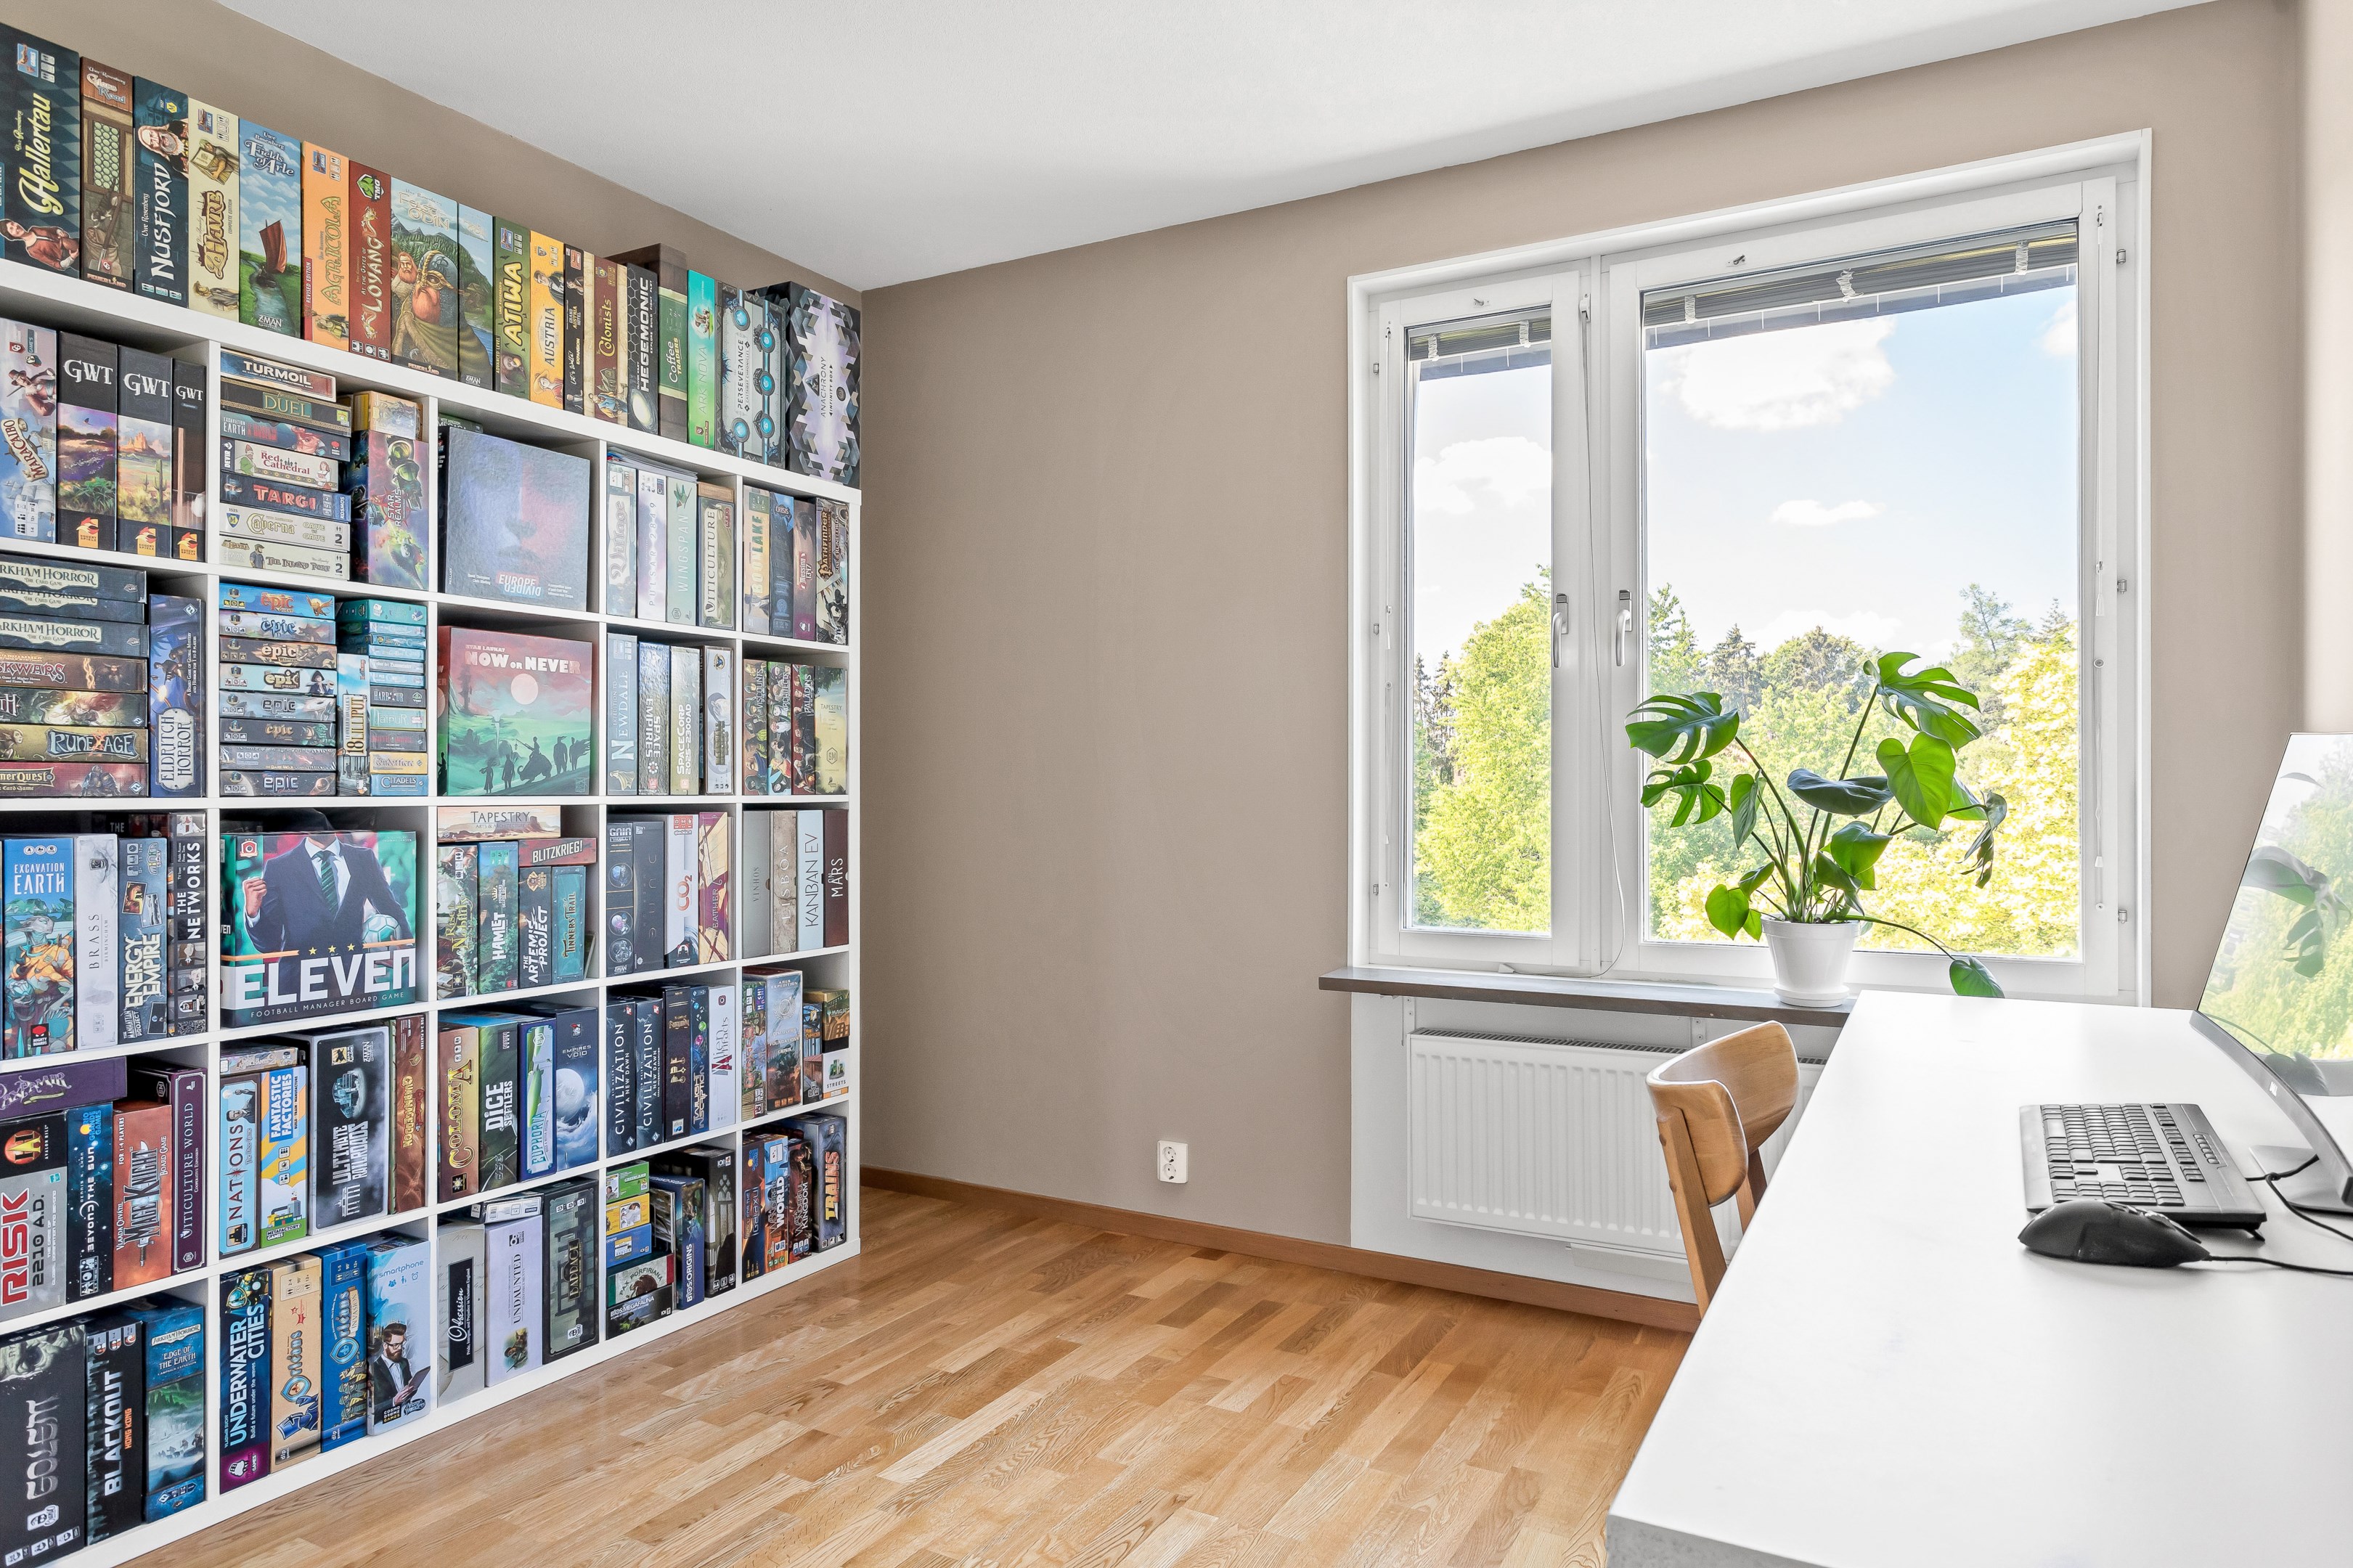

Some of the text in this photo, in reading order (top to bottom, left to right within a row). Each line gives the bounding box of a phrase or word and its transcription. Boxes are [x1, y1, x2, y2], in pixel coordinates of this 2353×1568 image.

[97, 86, 126, 105] Road
[18, 92, 64, 216] Hallertau
[244, 139, 284, 167] Fields of
[255, 134, 285, 151] Rosenberg
[264, 131, 277, 141] Uwe
[254, 159, 295, 176] Arle
[141, 193, 150, 224] Rosenberg
[150, 162, 176, 281] NUSFJORD
[320, 196, 345, 306] AGRICOLA
[361, 236, 386, 313] LOYANG
[502, 261, 523, 347] ATIWA
[544, 307, 555, 367] AUSTRIA
[598, 298, 616, 358] Colonists
[640, 277, 650, 393] HEGEMONIC
[63, 359, 114, 385] GWT
[243, 360, 311, 386] TURMOIL
[665, 340, 678, 383] Coffee
[698, 346, 708, 415] ARK NOVA
[123, 372, 170, 398] GWT
[175, 385, 204, 401] GWT
[264, 393, 311, 419] DUEL
[3, 419, 46, 478] MARACAIBO
[223, 422, 246, 436] EARTH
[261, 452, 280, 463] Red
[263, 458, 311, 475] Cathedral
[253, 484, 317, 510] TARGI
[246, 513, 295, 535] Caverna
[302, 521, 326, 531] CAVE
[302, 532, 326, 542] CAVE
[334, 534, 343, 545] 2
[820, 511, 832, 576] PATHFINDER
[334, 563, 343, 574] 2
[677, 514, 689, 592] WINGSPAN
[705, 511, 716, 613] VITICULTURE
[44, 568, 97, 588] HORROR
[498, 574, 537, 587] EUROPE
[648, 550, 657, 607] PULSAR
[46, 624, 100, 640] HORROR
[261, 645, 297, 661] epic
[465, 650, 582, 674] NOW NEVER
[262, 699, 296, 713] epic
[611, 671, 635, 761] NEWDALE
[49, 730, 136, 756] RUNE AGE
[160, 715, 175, 783] ELDRITCH
[177, 721, 193, 777] HORROR
[645, 698, 653, 758] EMPIRES
[653, 716, 661, 758] SPACE
[264, 776, 298, 793] epic
[380, 776, 417, 788] CITADELS
[110, 822, 125, 833] THE
[470, 811, 530, 823] TAPESTRY
[14, 862, 65, 875] EXCAVATION
[532, 840, 584, 863] BLITZKRIEG!
[14, 873, 65, 895] EARTH
[187, 842, 201, 939] NETWORKS
[778, 844, 791, 922] LISBOA
[804, 833, 819, 928] KANBAN EV
[831, 857, 844, 898] MARS
[178, 891, 187, 915] THE
[564, 891, 576, 917] TRAIL
[88, 914, 99, 970] BRASS
[492, 912, 507, 961] HAMLET
[528, 906, 542, 984] ARTEMIS
[537, 906, 548, 973] PROJECT
[124, 936, 144, 1009] ENERGY
[143, 933, 162, 1000] EMPIRE
[235, 948, 415, 1009] ELEVEN
[250, 992, 404, 1018] FOOTBALL MANAGER BOARD GAME
[562, 1044, 592, 1055] EMPIRES
[566, 1050, 588, 1059] VOID
[614, 1022, 625, 1135] CIVILIZATION
[643, 1022, 653, 1127] CIVILIZATION
[826, 1079, 847, 1089] STREETS
[270, 1075, 282, 1138] FANTASTIC
[281, 1073, 293, 1137] FACTORIES
[448, 1058, 475, 1169] COLOMA
[486, 1082, 504, 1133] DICE
[503, 1080, 513, 1127] SETTLERS
[160, 1135, 168, 1156] GAME
[333, 1124, 351, 1185] ULTIMATE
[348, 1121, 369, 1181] RAILROADS
[531, 1111, 547, 1166] EUPHORIA
[180, 1102, 194, 1239] VITICULTURE WORLD
[825, 1151, 839, 1221] TRAINS
[776, 1176, 785, 1229] WORLD
[1, 1188, 30, 1307] RISK
[32, 1194, 45, 1287] 2210 A.D.
[378, 1259, 424, 1279] smartphone
[619, 1267, 663, 1296] PAX PORFIRIANA
[176, 1325, 200, 1336] HORROR
[247, 1303, 265, 1360] CITIES
[446, 1287, 468, 1342] Obsession
[159, 1352, 196, 1370] THE EARTH
[163, 1345, 191, 1360] EDGE OF
[229, 1315, 248, 1447] UNDERWATER
[104, 1371, 123, 1497] BLACKOUT
[124, 1408, 133, 1450] HONG KONG
[383, 1413, 400, 1423] GAMES
